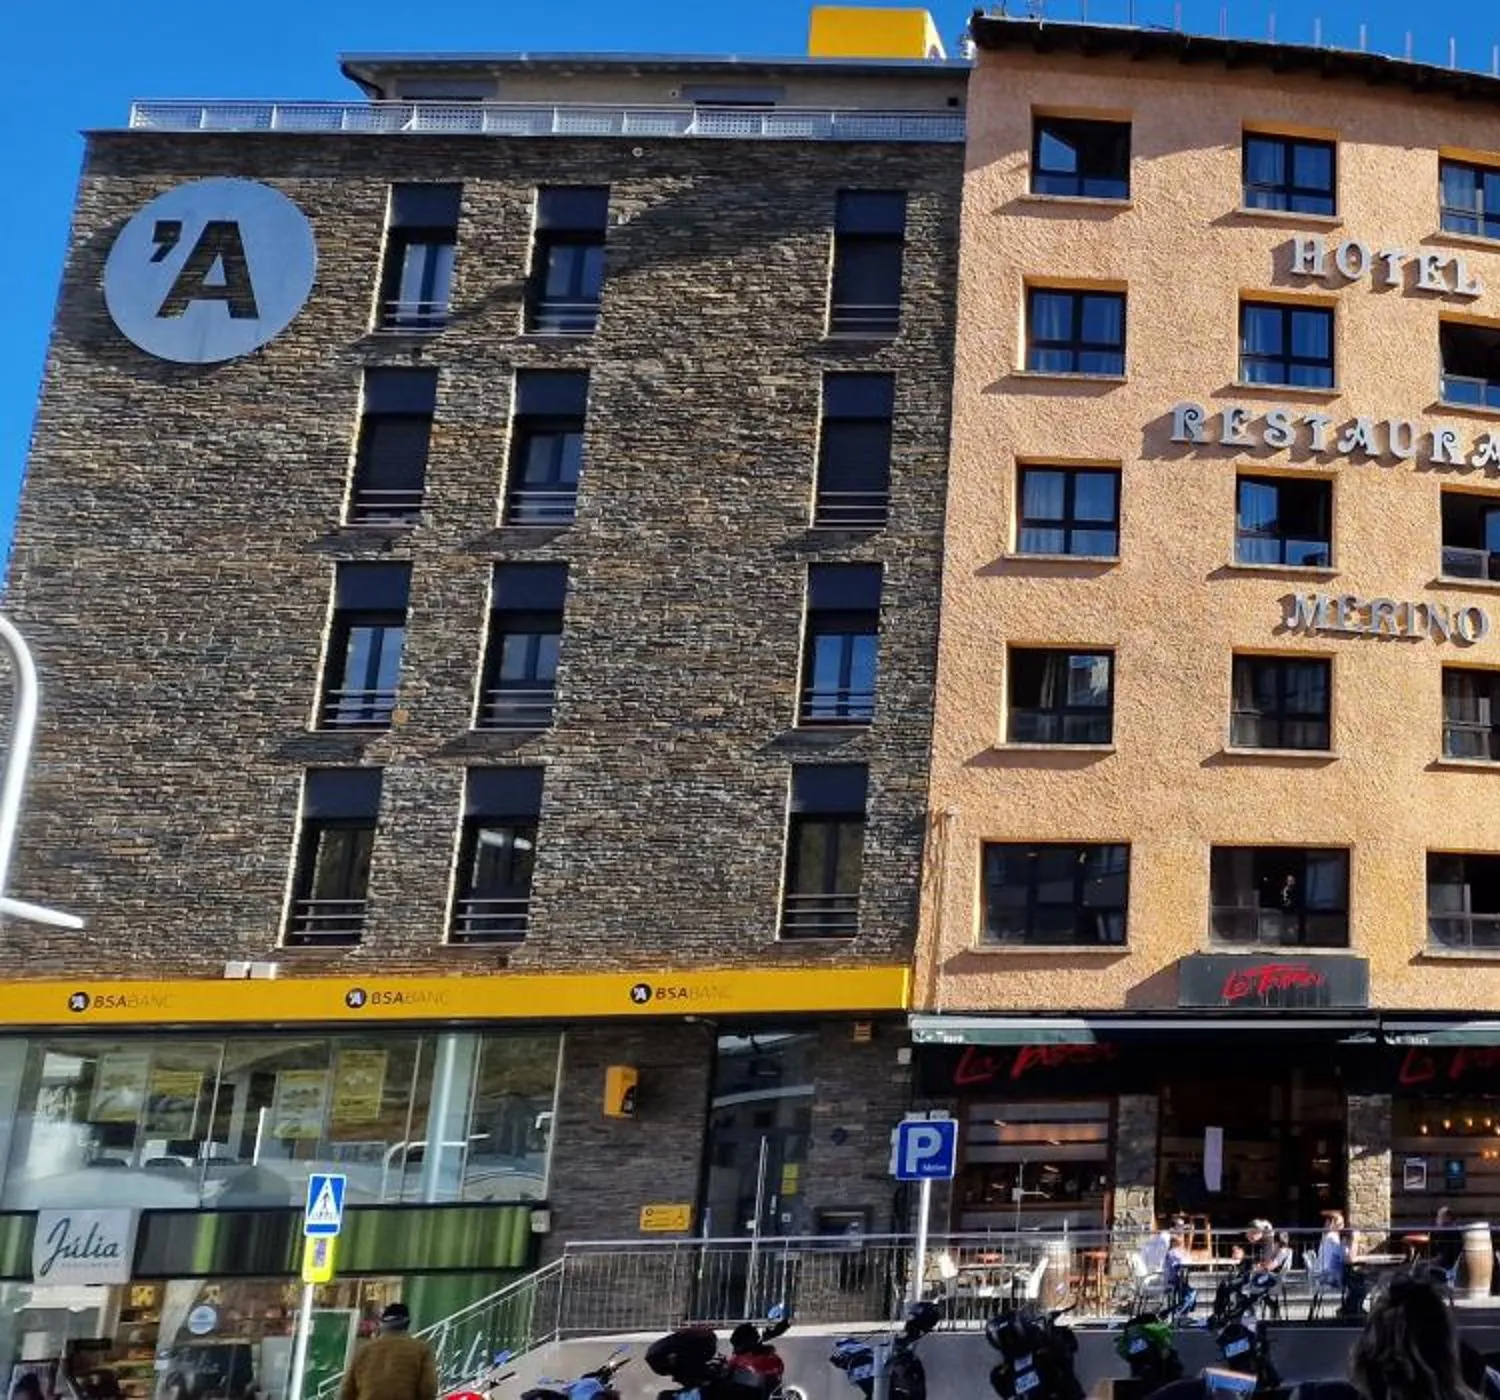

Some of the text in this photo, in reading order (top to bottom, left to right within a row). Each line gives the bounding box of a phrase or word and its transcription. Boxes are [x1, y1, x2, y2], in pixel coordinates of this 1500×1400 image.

[1291, 237, 1484, 297] HOTEL
[1286, 593, 1491, 645] MERINO
[906, 1127, 943, 1173] P
[40, 1217, 119, 1277] Júlia
